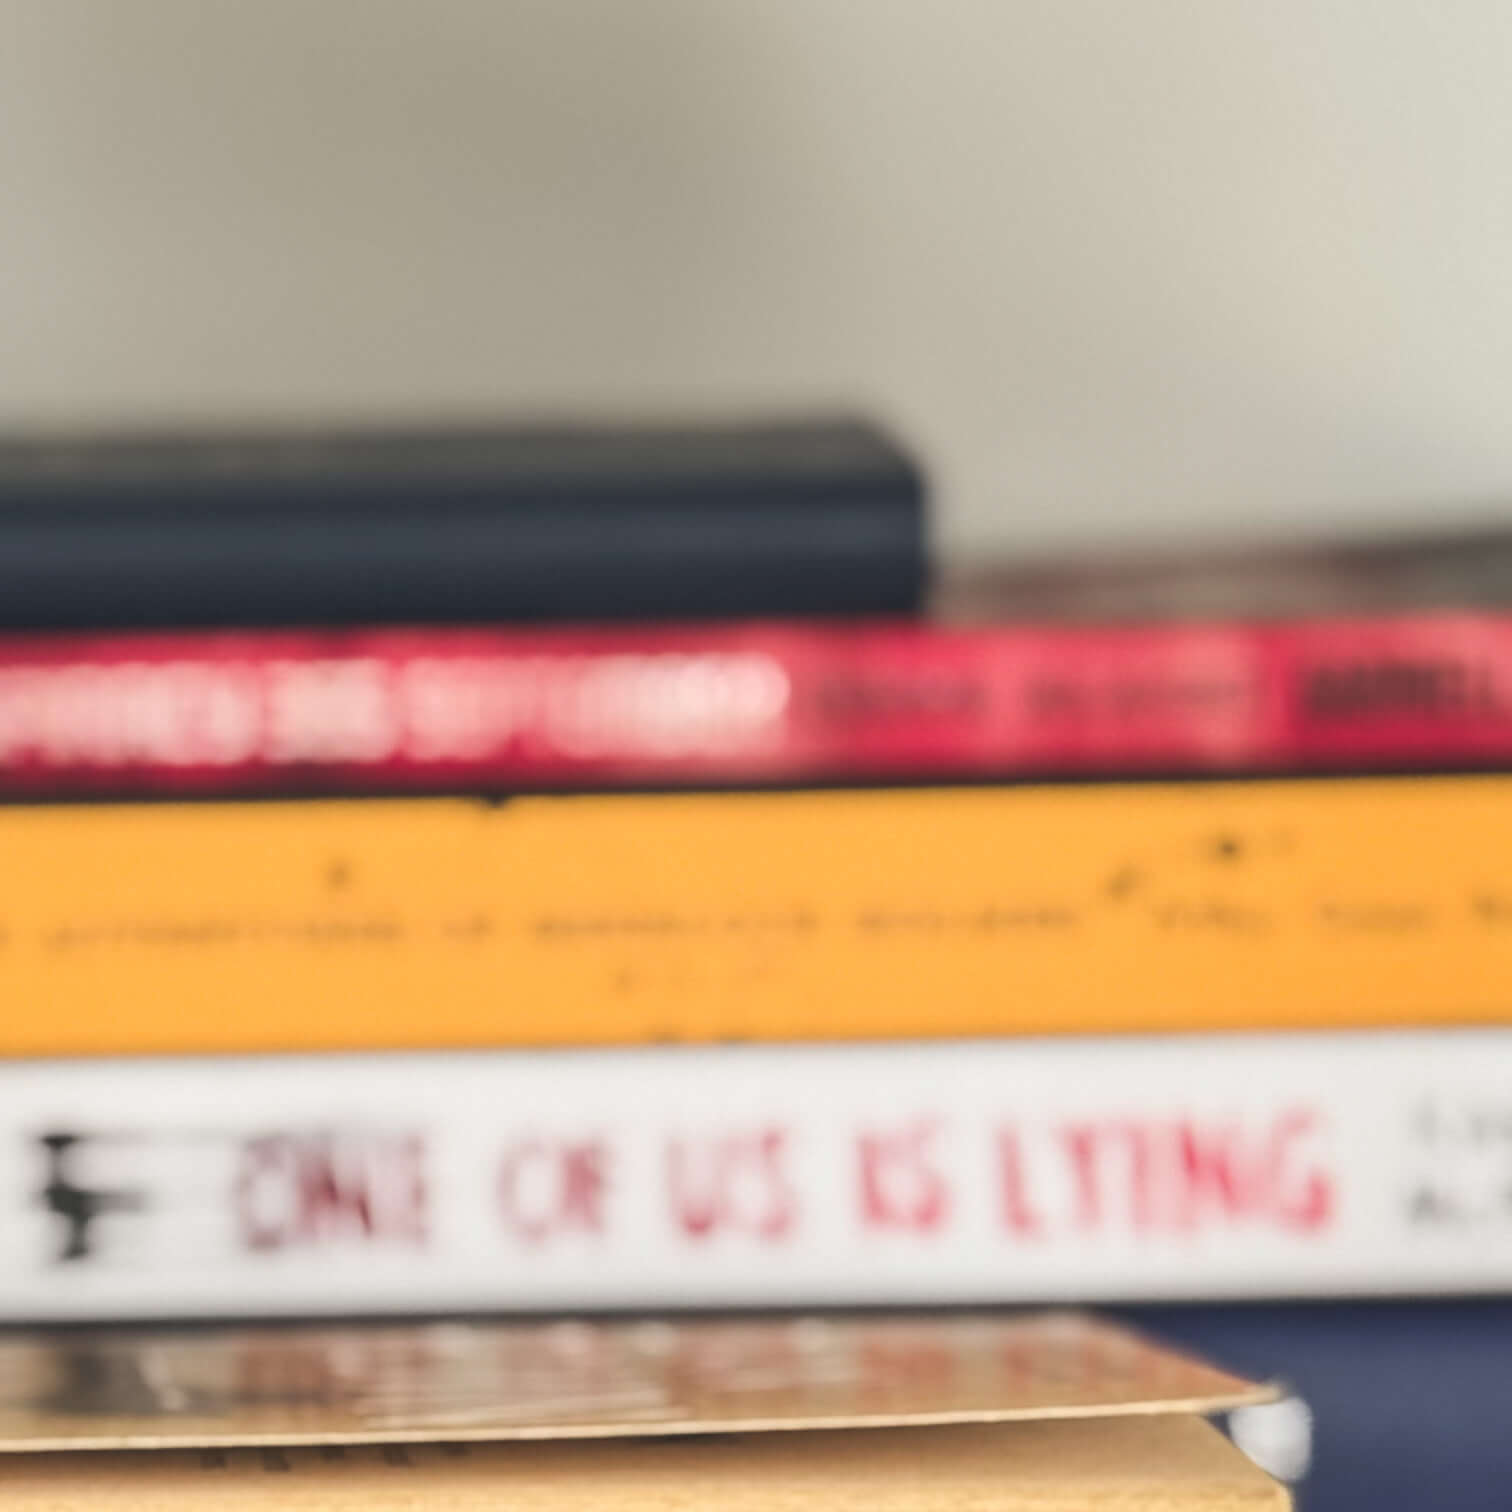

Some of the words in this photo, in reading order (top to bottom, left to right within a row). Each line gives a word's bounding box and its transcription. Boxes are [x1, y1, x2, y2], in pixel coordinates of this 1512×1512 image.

[229, 1128, 433, 1256] ONE
[494, 1128, 616, 1246] OF
[660, 1120, 800, 1245] US
[854, 1108, 954, 1241] IS
[990, 1098, 1338, 1244] LYING
